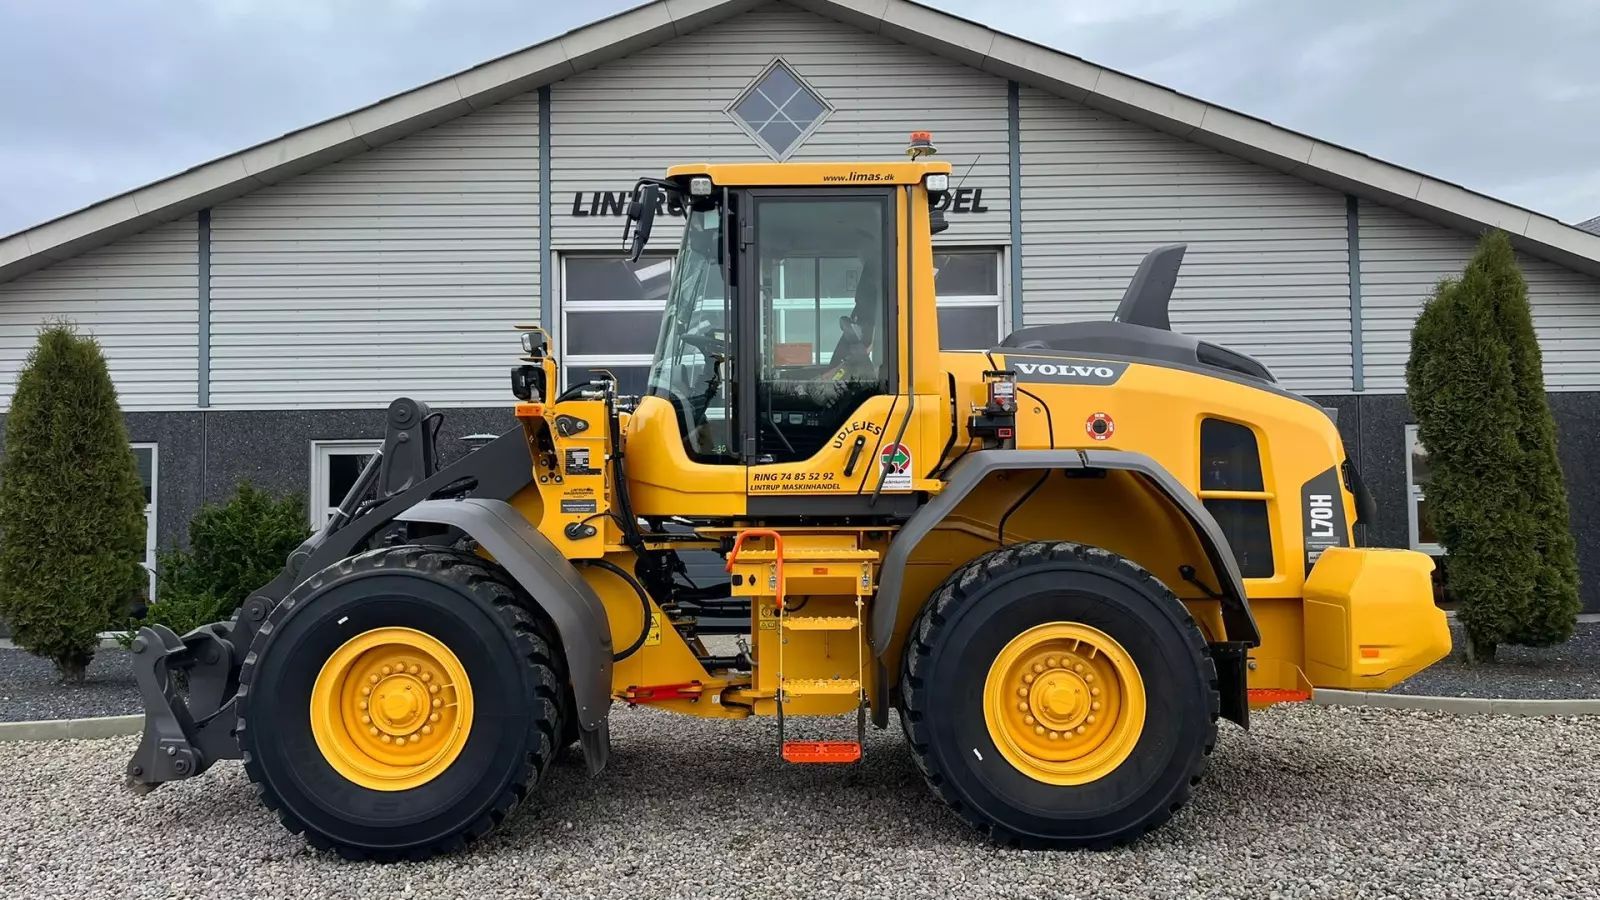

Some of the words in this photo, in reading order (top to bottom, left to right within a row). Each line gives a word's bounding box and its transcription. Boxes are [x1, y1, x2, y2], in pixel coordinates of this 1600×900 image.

[823, 171, 895, 181] www.limas.dk
[1014, 363, 1114, 378] VOLVO
[833, 421, 882, 449] UDLEJES
[753, 473, 778, 481] RING
[794, 472, 806, 480] 85
[808, 472, 820, 480] 52
[822, 472, 834, 480] 92
[1309, 494, 1334, 537] L70H
